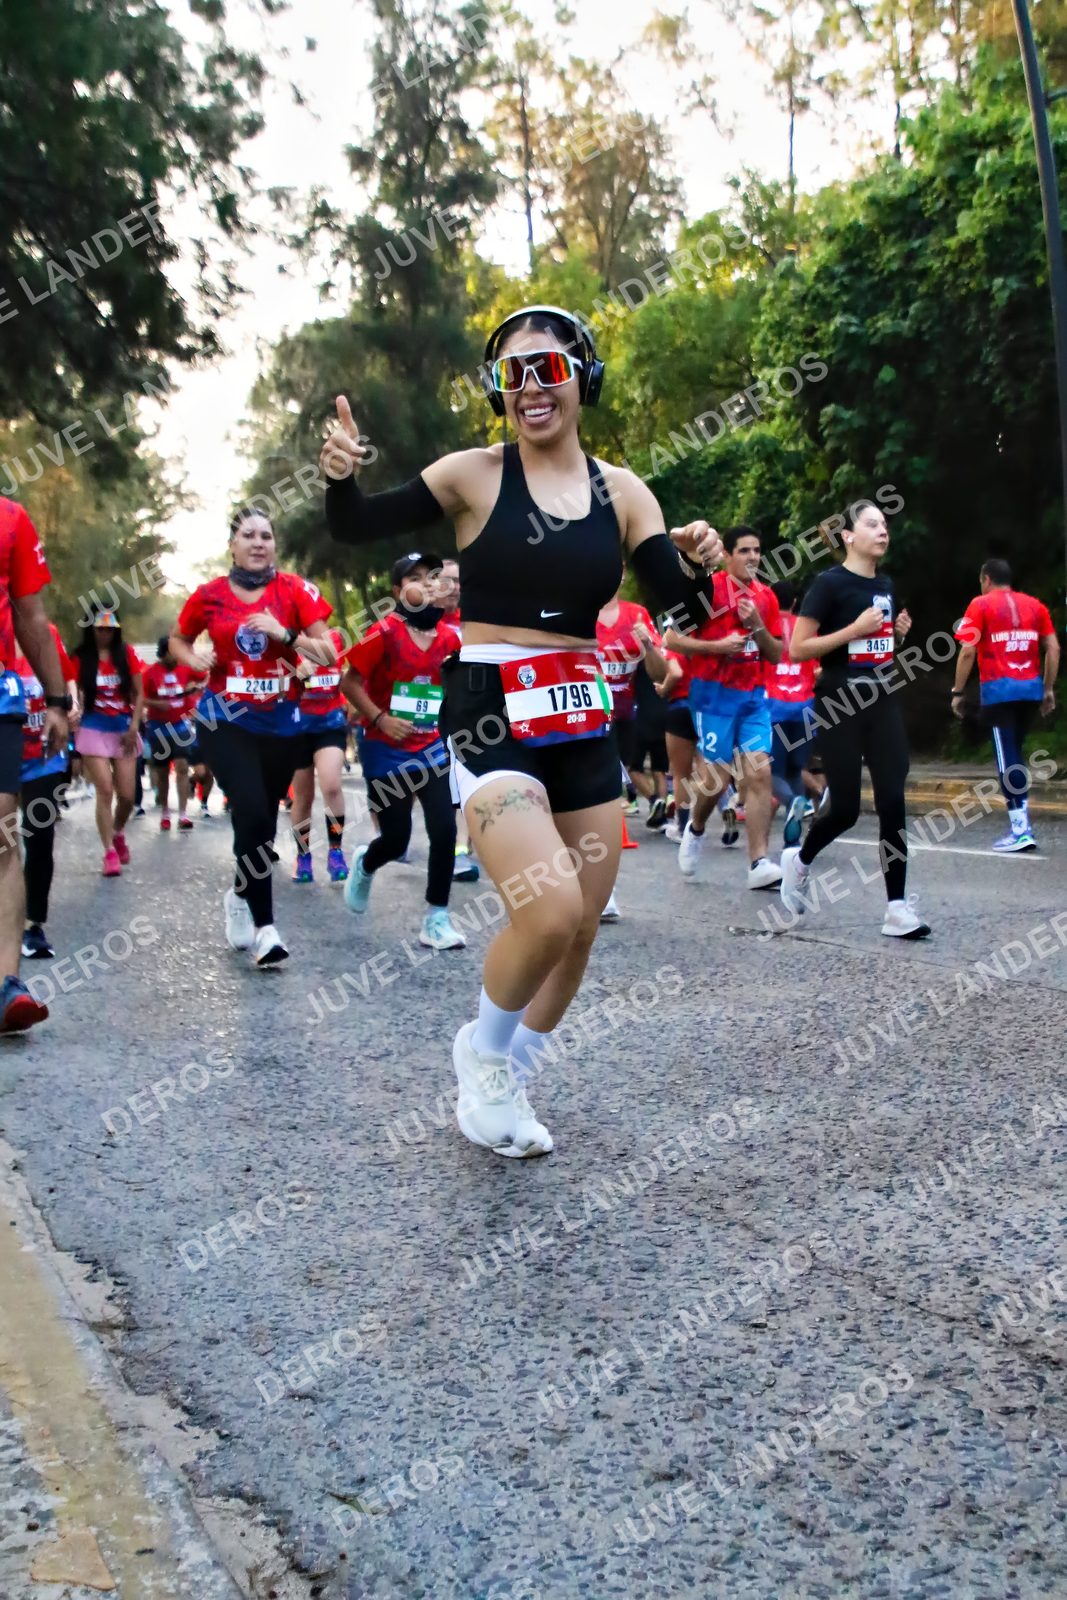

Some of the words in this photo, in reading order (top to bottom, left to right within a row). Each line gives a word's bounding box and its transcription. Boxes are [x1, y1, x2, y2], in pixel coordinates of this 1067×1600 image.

[246, 680, 273, 693] 2244
[547, 684, 593, 712] 1796
[416, 700, 429, 713] 69
